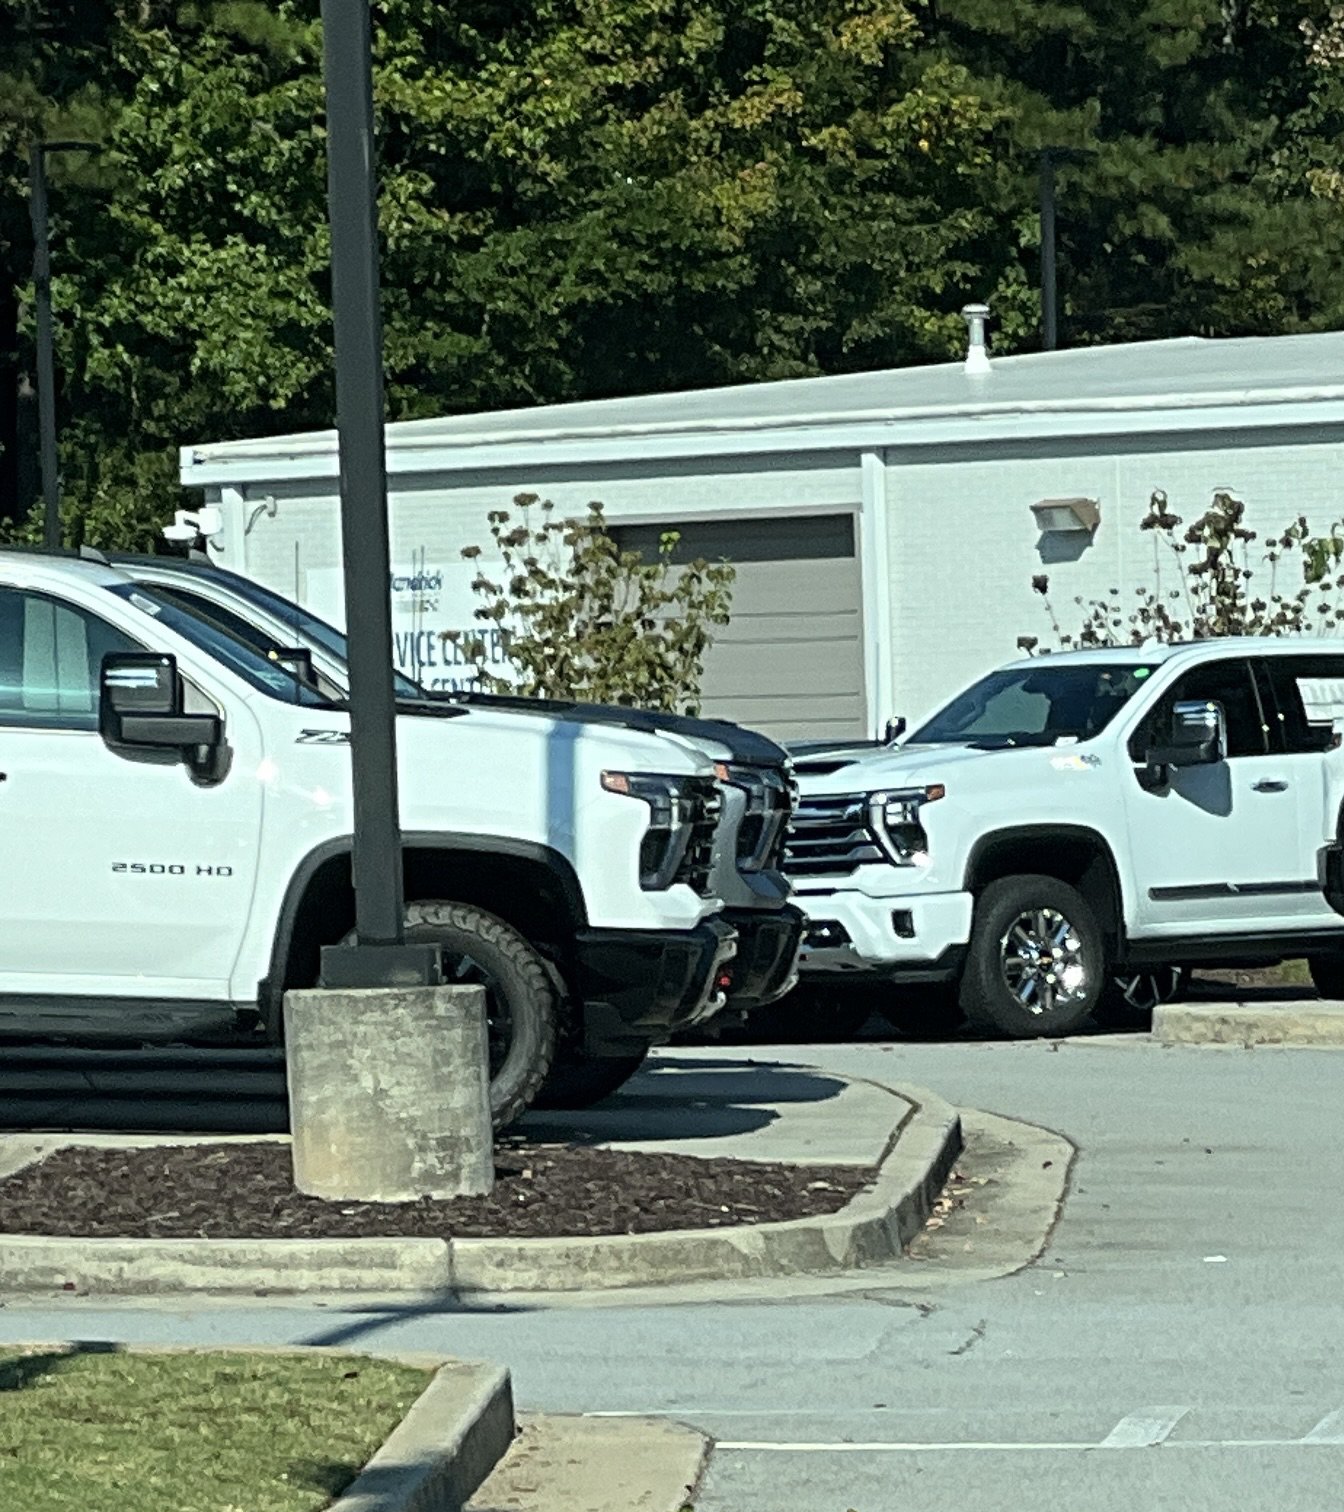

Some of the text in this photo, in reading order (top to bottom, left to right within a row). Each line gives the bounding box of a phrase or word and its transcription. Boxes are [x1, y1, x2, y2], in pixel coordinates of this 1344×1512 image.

[395, 630, 437, 668] VICE
[111, 861, 233, 877] 2500 HD
